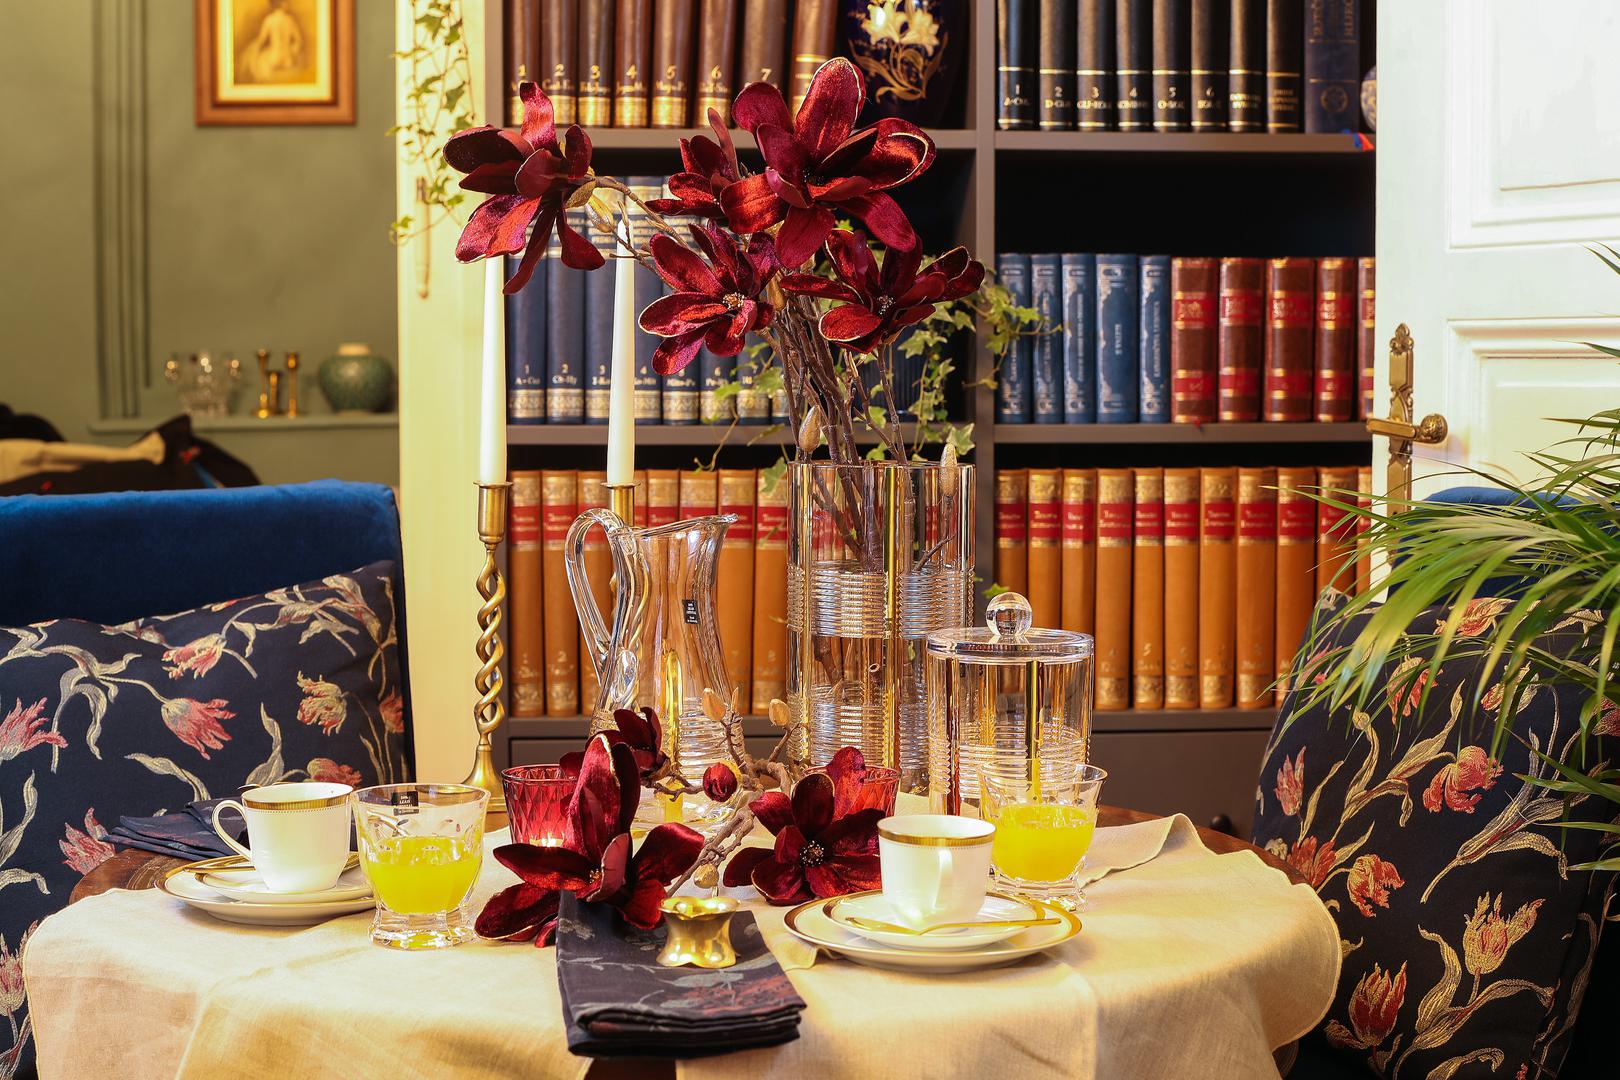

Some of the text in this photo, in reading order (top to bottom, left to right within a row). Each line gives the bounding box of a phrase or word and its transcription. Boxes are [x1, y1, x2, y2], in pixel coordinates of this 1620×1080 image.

[518, 64, 526, 77] 1
[553, 64, 565, 77] 2
[590, 65, 601, 79] 3
[626, 64, 637, 79] 4
[666, 65, 677, 80] 5
[711, 64, 722, 79] 6
[761, 68, 772, 82] 7
[1015, 84, 1020, 95] 1
[1054, 86, 1063, 98] 2
[1091, 86, 1100, 98] 3
[1129, 86, 1138, 98] 4
[1168, 86, 1177, 98] 5
[524, 364, 530, 374] 1
[562, 363, 569, 374] 2
[599, 364, 606, 375] 3
[640, 365, 647, 375] 4
[557, 650, 568, 663] 2
